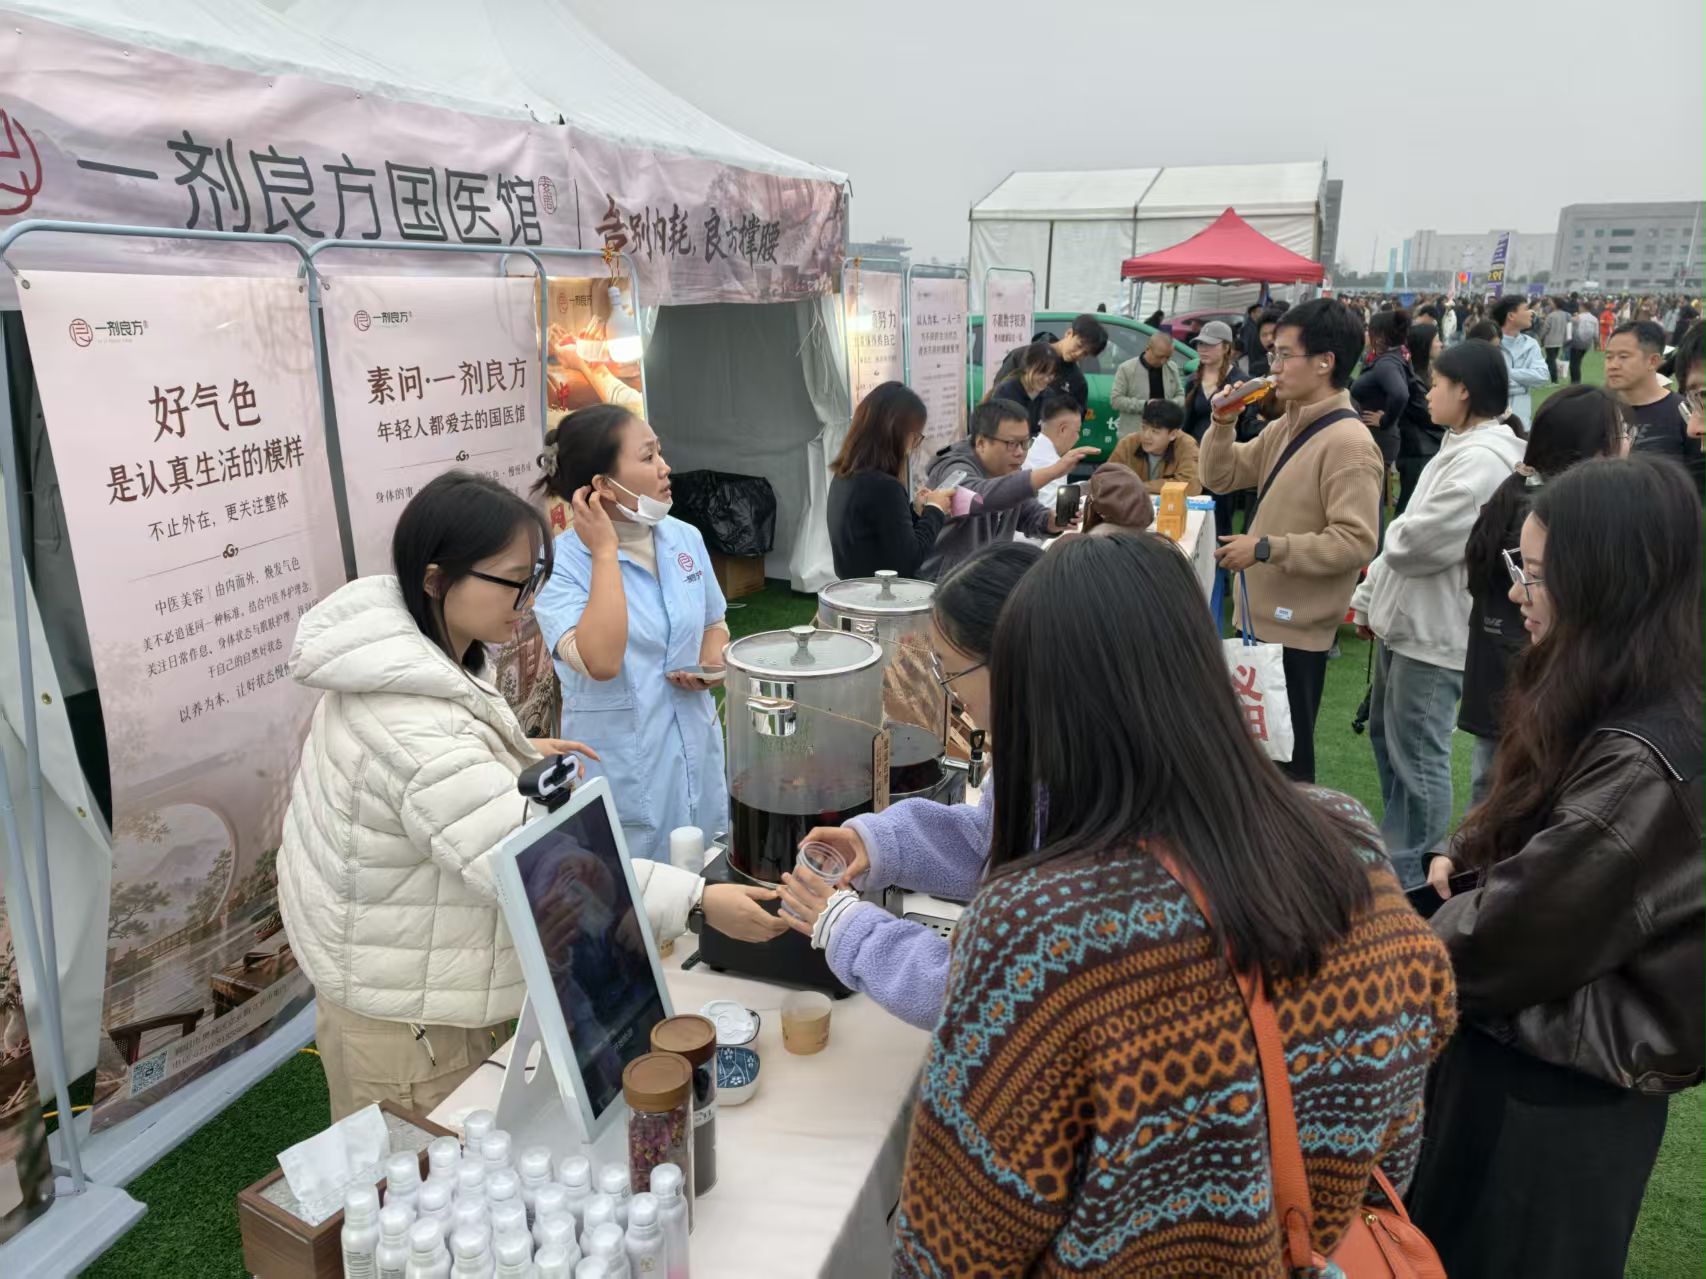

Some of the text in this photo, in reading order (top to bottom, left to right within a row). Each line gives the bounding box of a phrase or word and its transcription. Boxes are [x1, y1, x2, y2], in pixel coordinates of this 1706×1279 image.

[77, 129, 542, 245] 一剂良方国医馆
[95, 320, 143, 336] 一剂良方
[372, 311, 408, 323] 一剂良方
[872, 310, 896, 329] 努力
[367, 357, 527, 405] 素问·一剂良方
[149, 378, 261, 442] 好气色
[377, 404, 525, 443] 年轻人都爱去的国医馆
[106, 434, 304, 505] 是认真生活的模样
[148, 491, 289, 541] 不止外在，更关注整体
